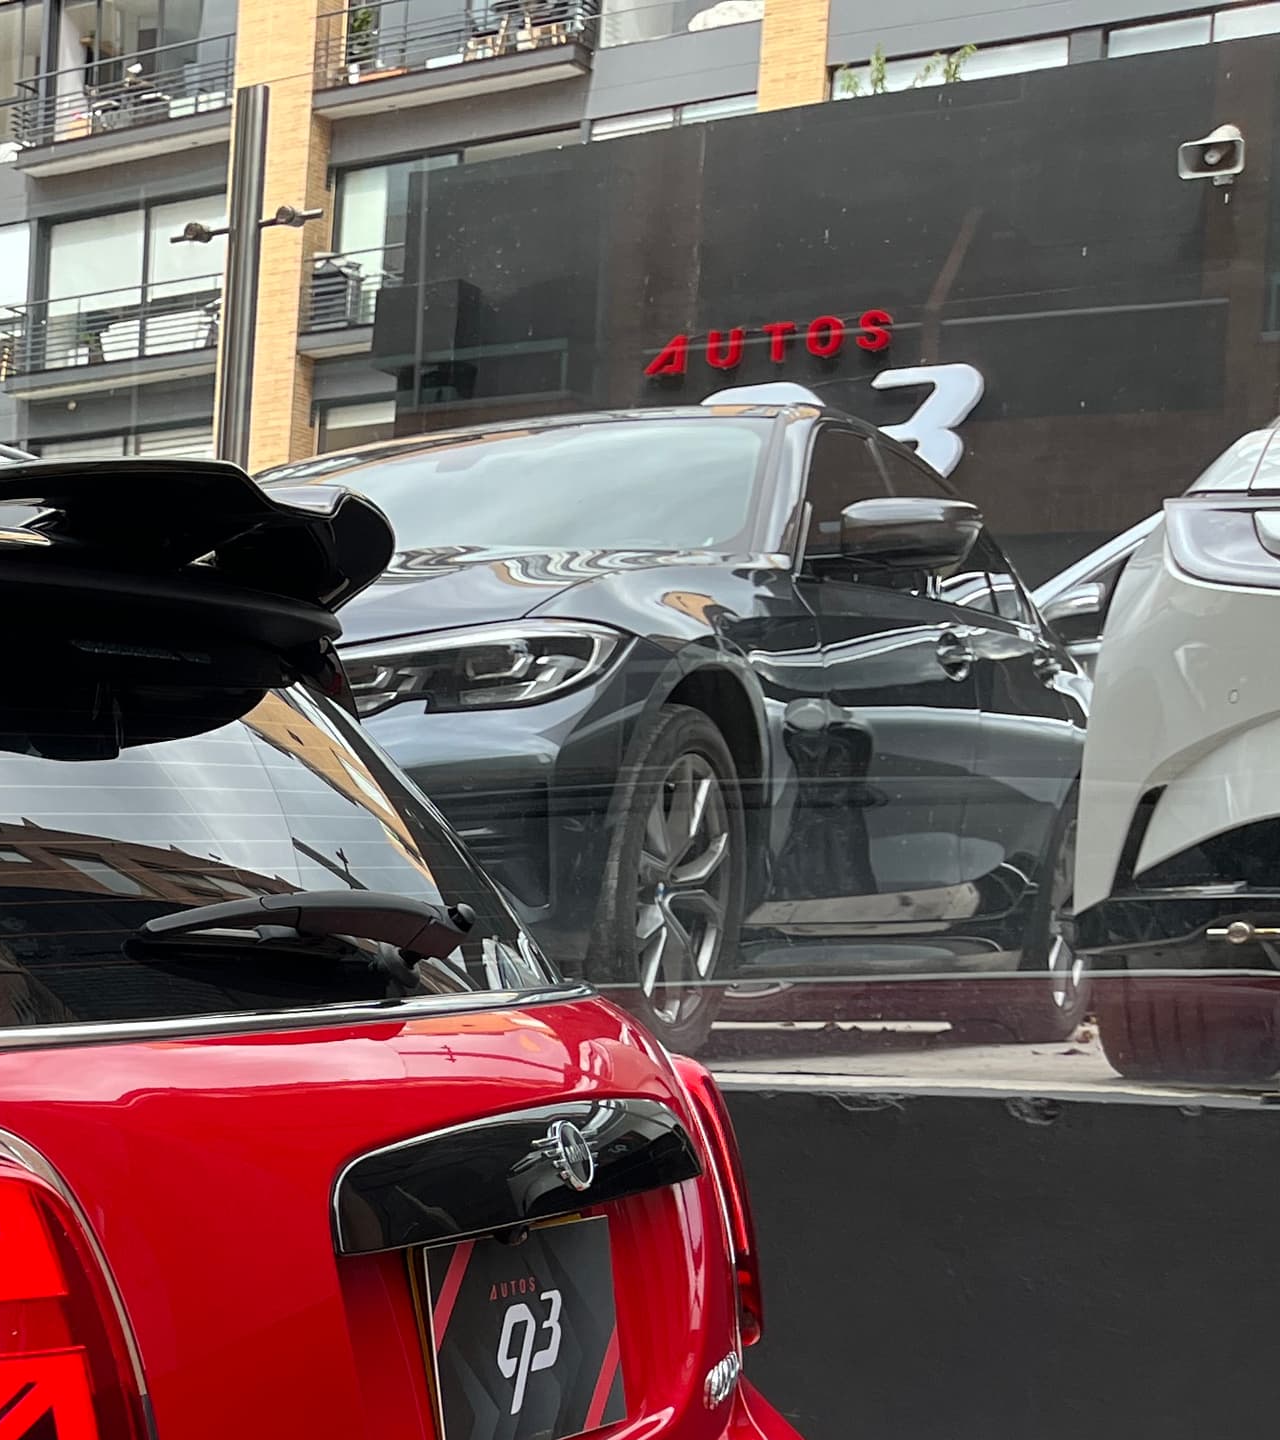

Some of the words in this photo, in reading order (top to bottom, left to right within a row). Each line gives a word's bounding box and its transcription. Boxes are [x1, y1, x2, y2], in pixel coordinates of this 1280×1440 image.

[644, 309, 893, 376] AUTOS
[490, 1277, 536, 1300] AUTOS
[497, 1289, 562, 1415] 93
